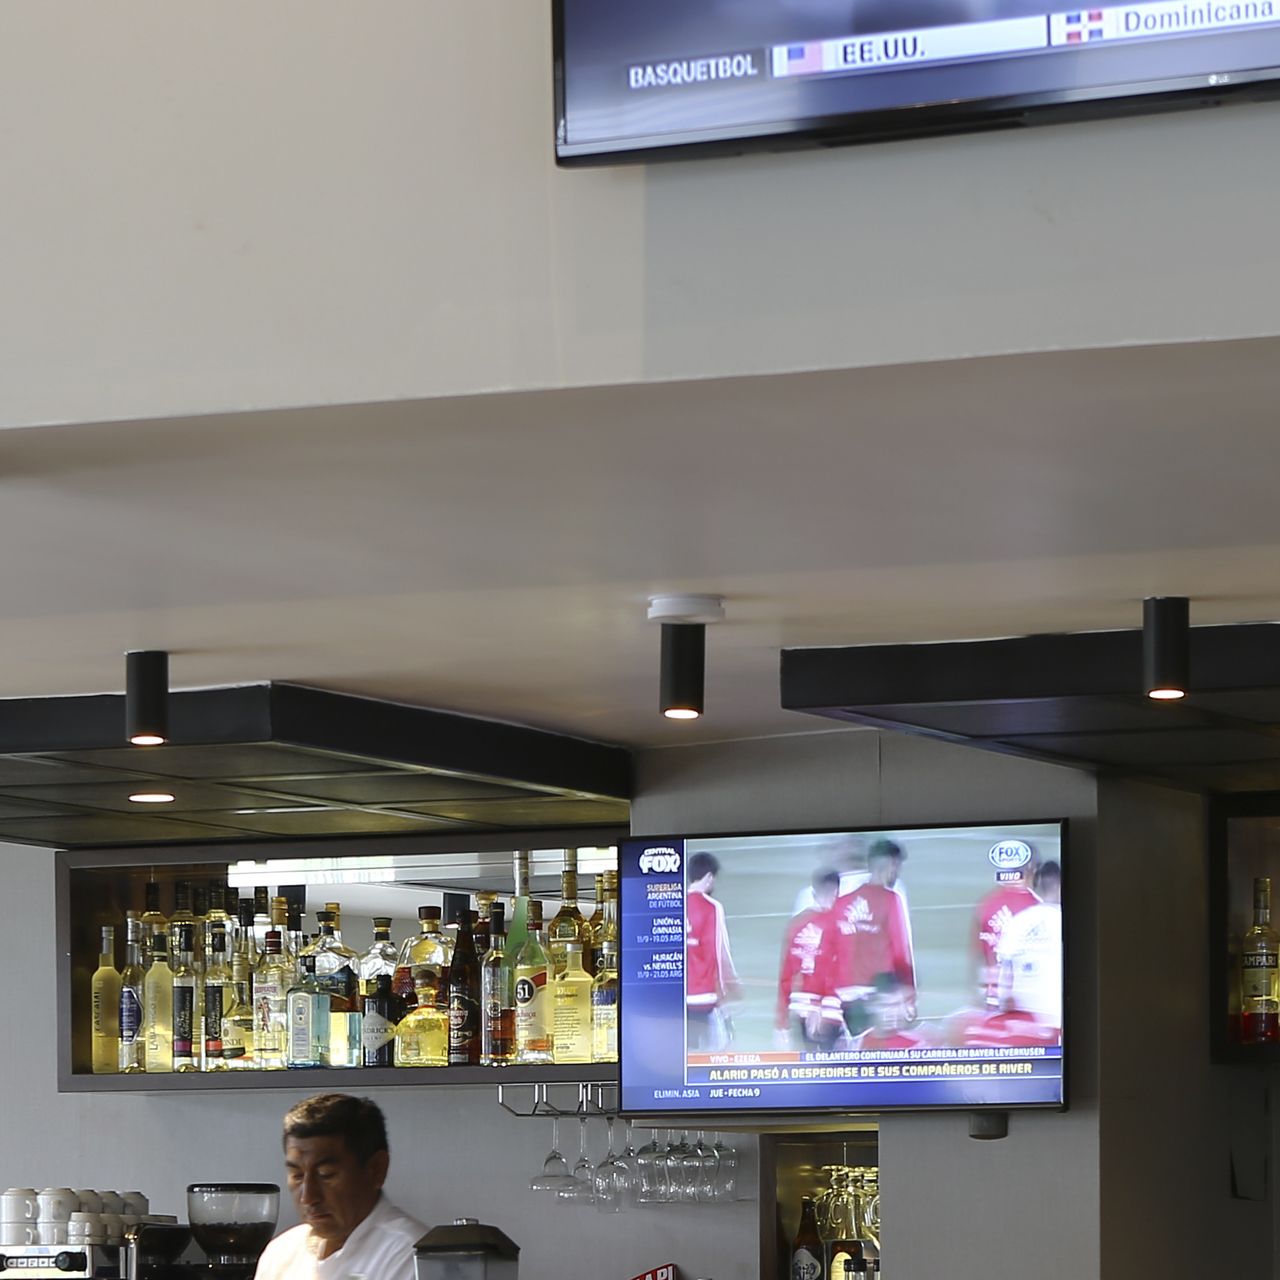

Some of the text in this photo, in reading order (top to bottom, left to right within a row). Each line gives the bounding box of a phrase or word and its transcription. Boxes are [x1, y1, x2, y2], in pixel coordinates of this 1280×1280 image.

[842, 36, 925, 65] EE.UU.
[628, 54, 758, 89] BASQUETBOL
[644, 847, 676, 856] CENTRAL
[998, 847, 1020, 857] FOX
[641, 855, 679, 874] FOX
[999, 872, 1021, 880] VIVO
[647, 883, 682, 892] SUPERLIGA
[647, 891, 682, 900] ARGENTINA
[653, 917, 673, 926] UNIÓN
[652, 925, 682, 934] GIMNASIA
[652, 951, 682, 961] HURACÁN
[517, 984, 530, 999] 51
[710, 1054, 761, 1063] VIVO EZEIZA
[805, 1047, 1046, 1061] EL DELANTERO CONTINUARÁ SU CARRERA EN BAYER LEVERKUSEN
[709, 1062, 1032, 1080] ALARIO PASÓ A DESPEDIRSE DE SUS COMPAÑEROS DE RIVER
[682, 1089, 700, 1098] ASIA
[710, 1088, 760, 1098] JUE FECHA 9
